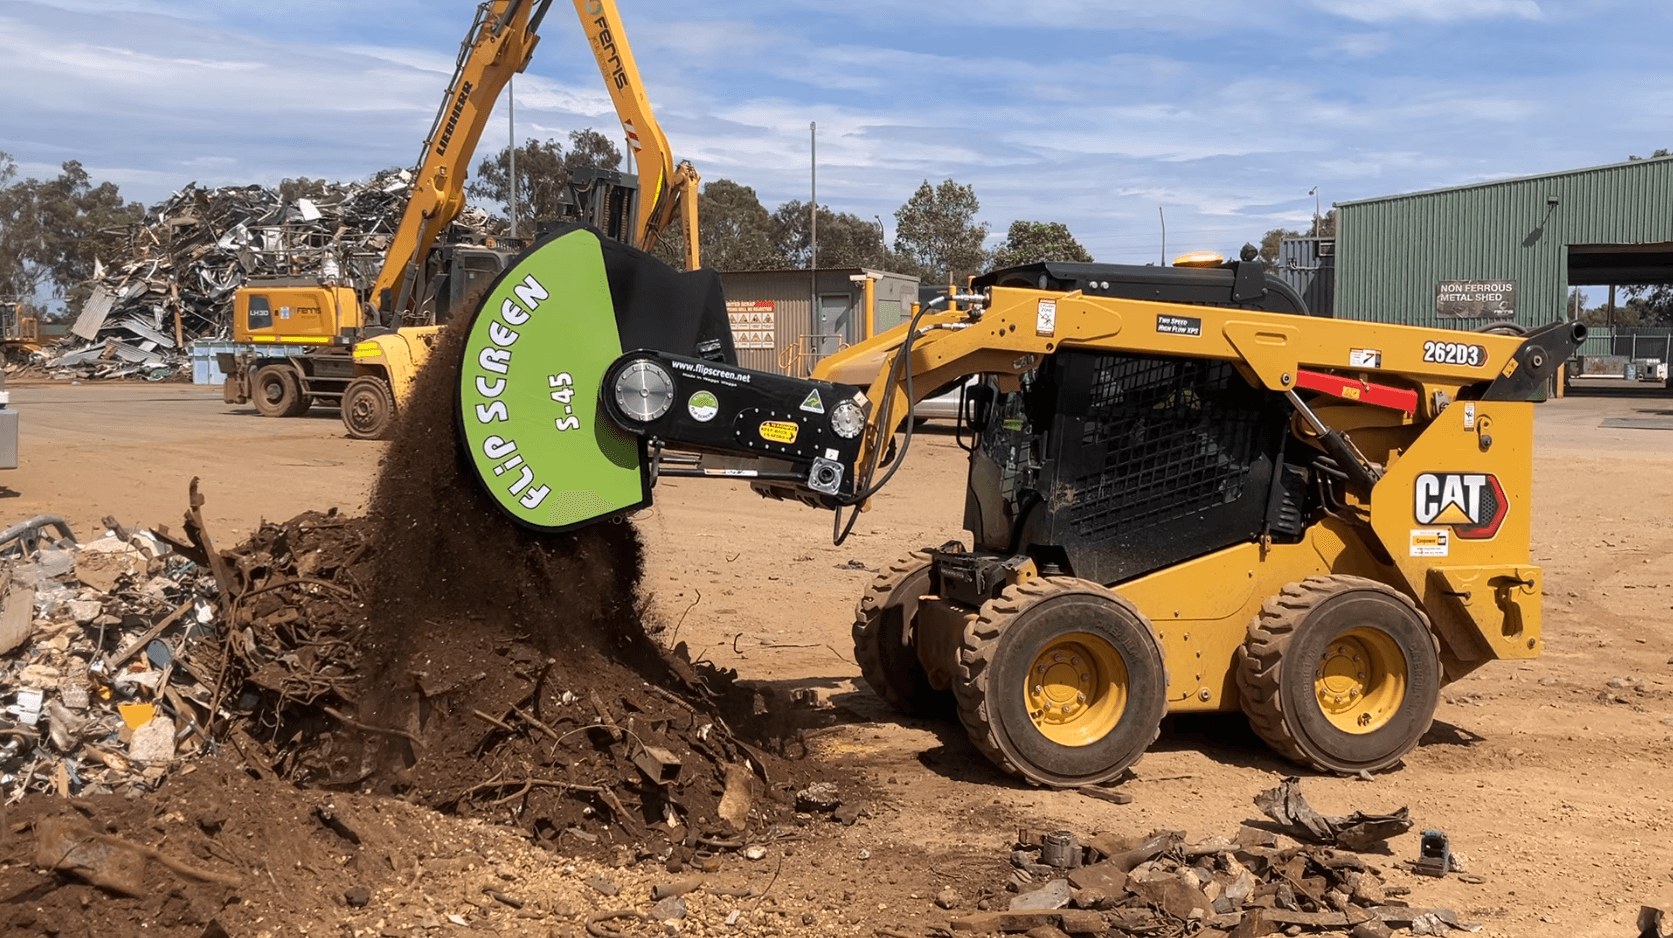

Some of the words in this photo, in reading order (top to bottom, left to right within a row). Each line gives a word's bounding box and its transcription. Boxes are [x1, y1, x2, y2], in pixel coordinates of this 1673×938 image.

[436, 81, 473, 157] LIEBHERR
[1440, 284, 1462, 292] NON
[1465, 283, 1512, 292] FERROUS
[1440, 293, 1473, 301] METAL
[1475, 293, 1503, 301] SHED
[475, 273, 550, 424] SCREEN
[1423, 341, 1479, 366] 262D3
[671, 360, 751, 383] www.flipscreen.net
[547, 371, 581, 432] S-45
[1415, 473, 1486, 524] CAT
